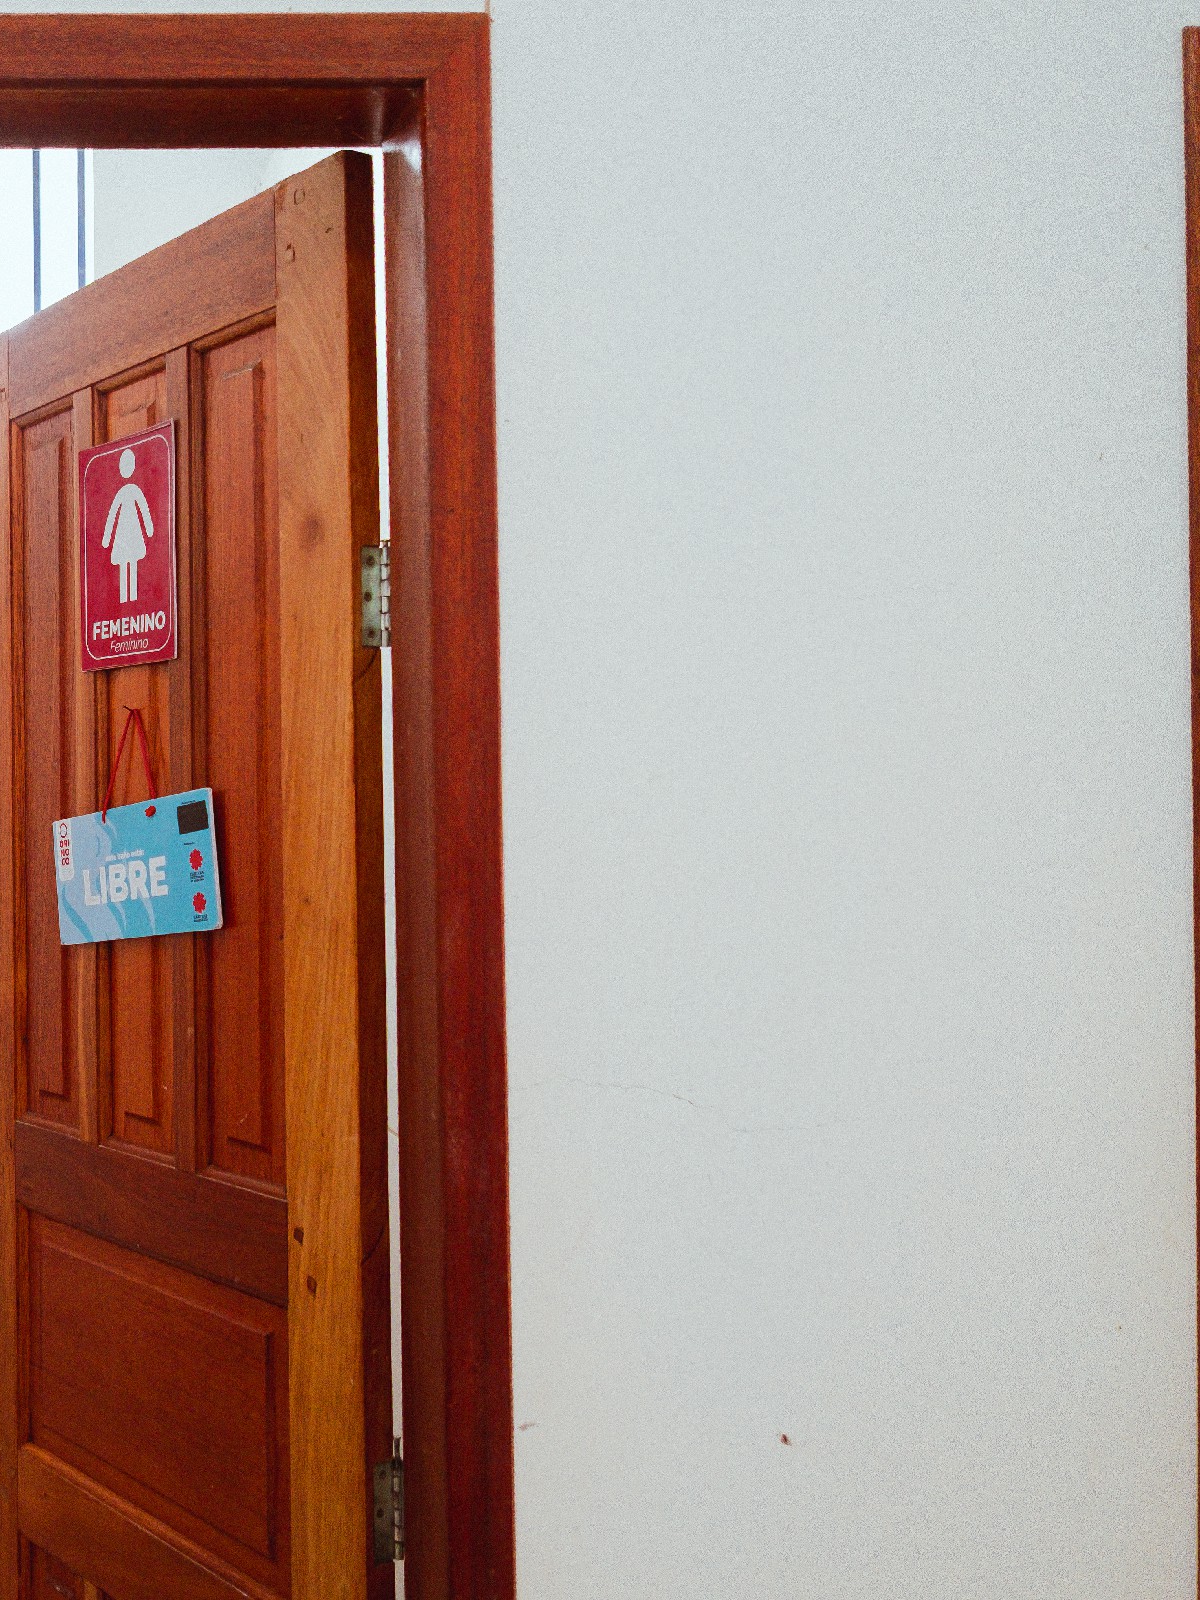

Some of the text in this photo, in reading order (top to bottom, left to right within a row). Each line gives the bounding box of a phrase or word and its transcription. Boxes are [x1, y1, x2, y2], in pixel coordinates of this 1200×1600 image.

[93, 610, 166, 640] FEMENINO
[110, 637, 149, 652] Feminino
[82, 855, 169, 906] LIBRE
